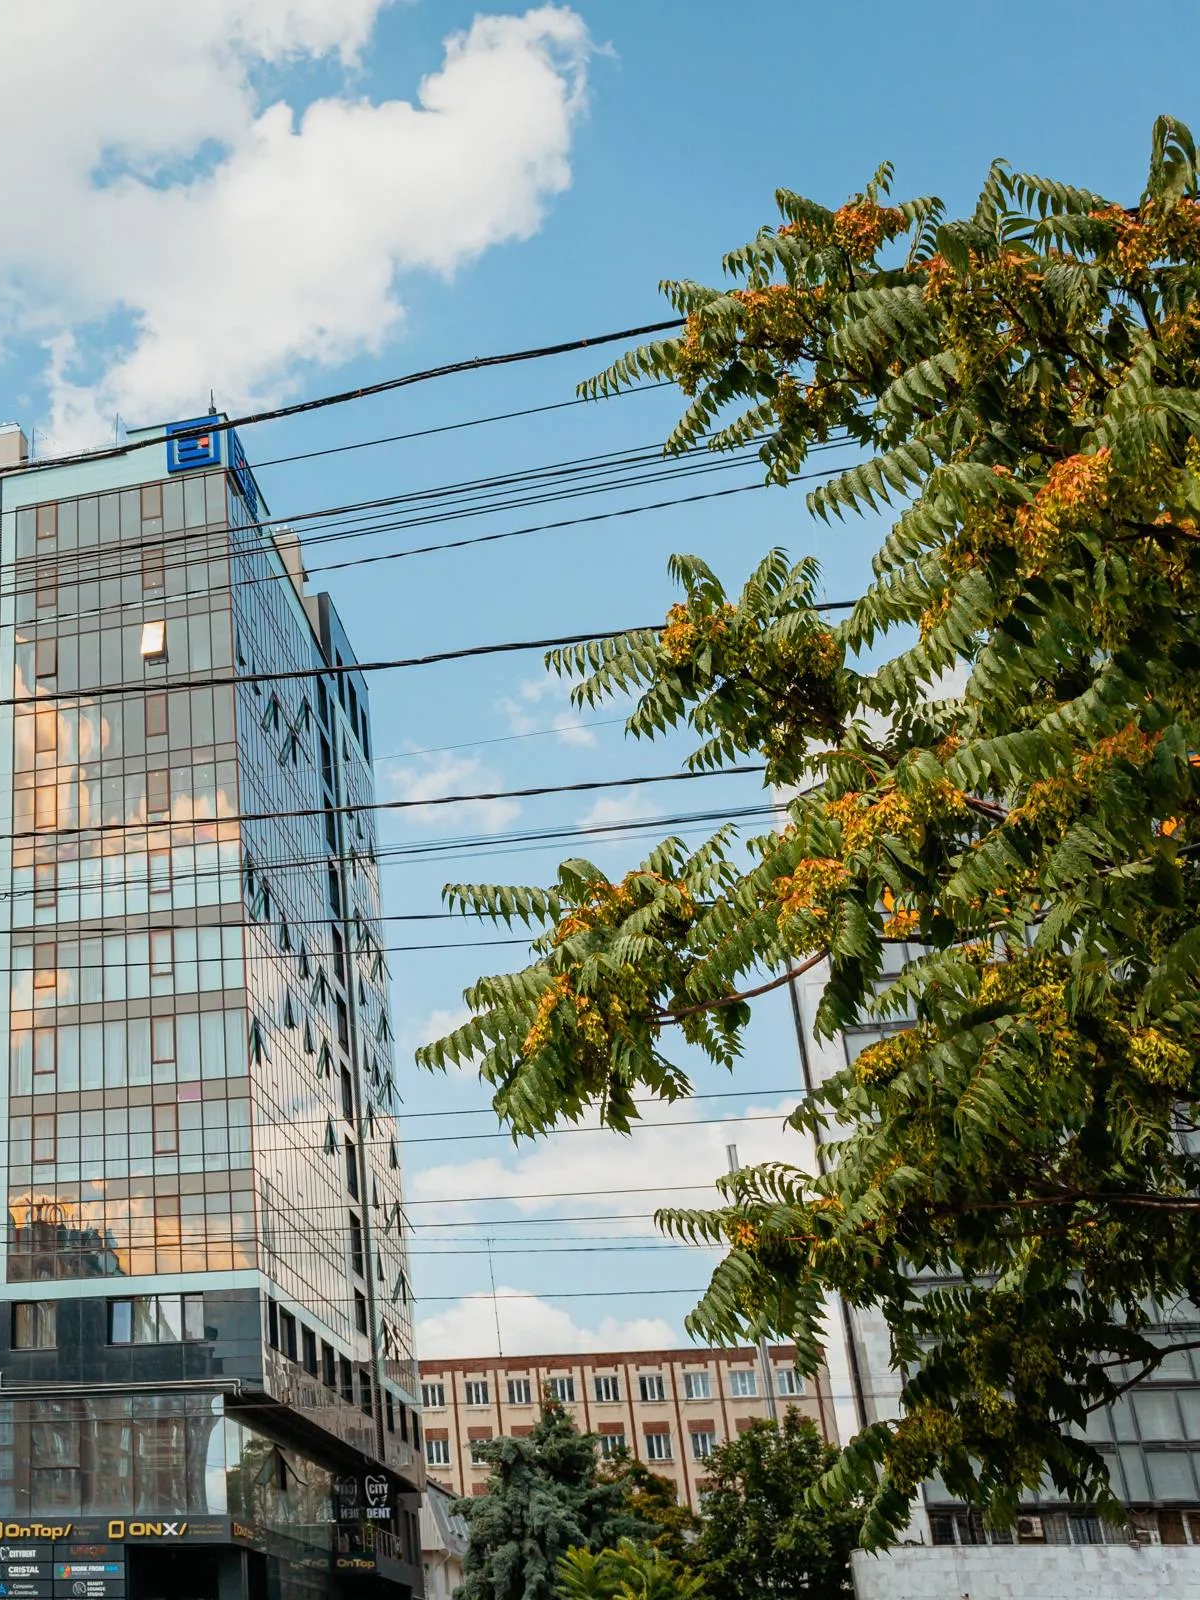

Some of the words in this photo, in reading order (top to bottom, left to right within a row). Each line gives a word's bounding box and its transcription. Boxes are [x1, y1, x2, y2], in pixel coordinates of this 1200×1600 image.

[368, 1483, 389, 1494] CITY
[366, 1507, 391, 1519] DENT
[8, 1565, 40, 1574] CRISTAL
[336, 1558, 375, 1570] OnTop
